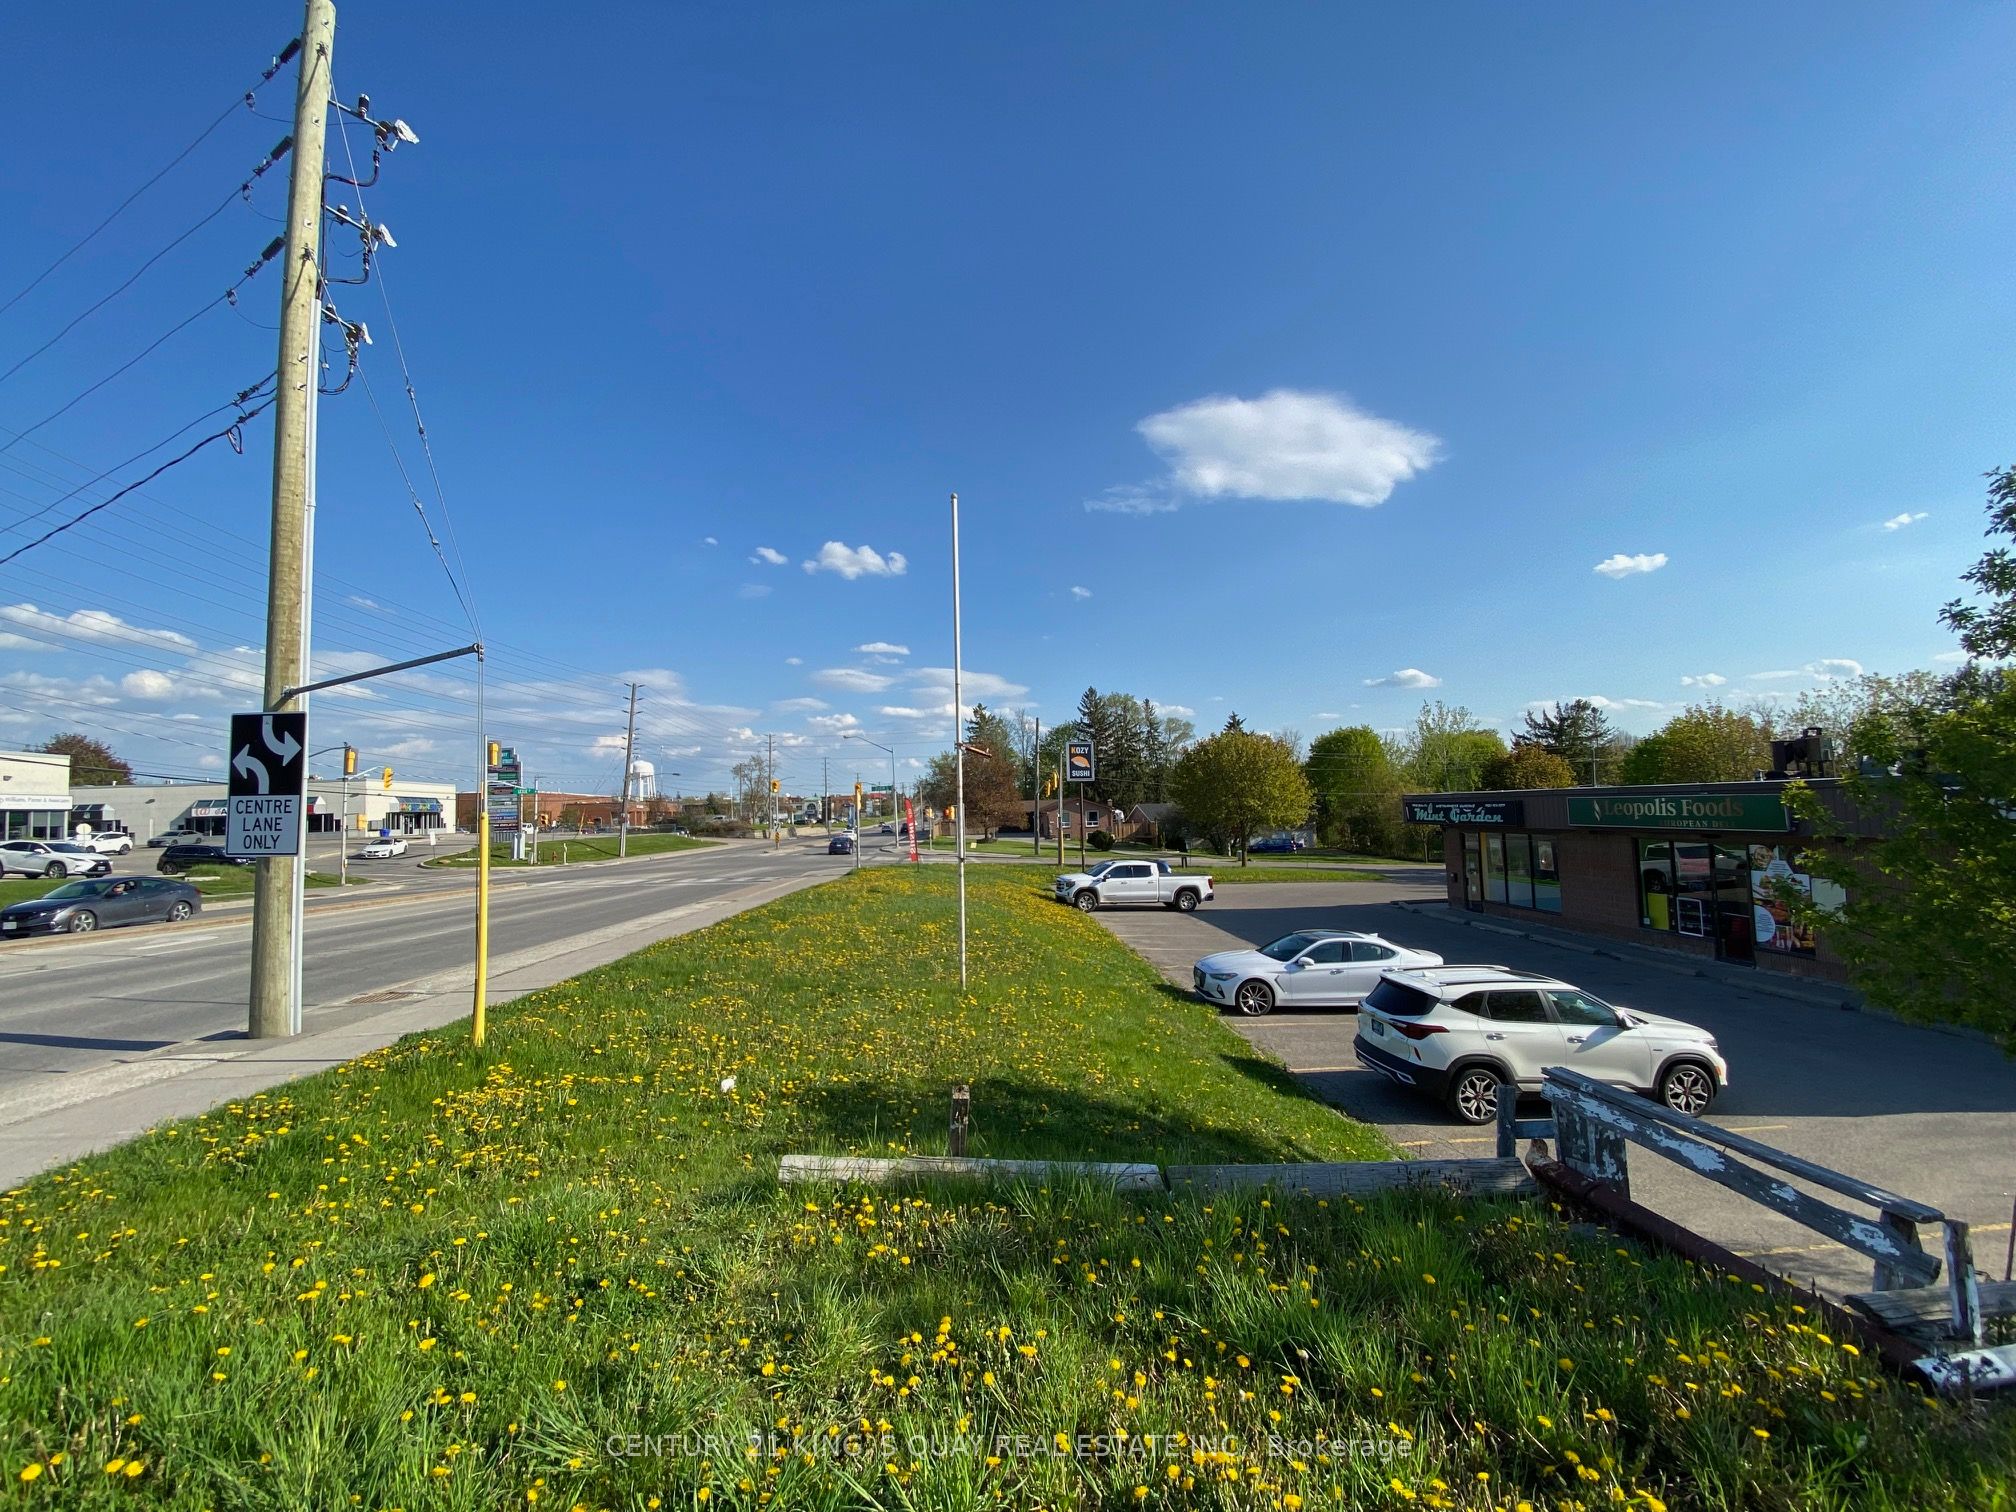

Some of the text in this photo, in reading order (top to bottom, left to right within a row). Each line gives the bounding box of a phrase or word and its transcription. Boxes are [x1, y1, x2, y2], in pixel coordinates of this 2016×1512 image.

[1071, 746, 1089, 754] KOZY
[236, 799, 293, 814] CENTRE
[1414, 804, 1504, 823] Mint Garden
[1604, 797, 1744, 820] Leopolis Foods
[242, 817, 283, 832] LANE
[243, 834, 281, 850] ONLY
